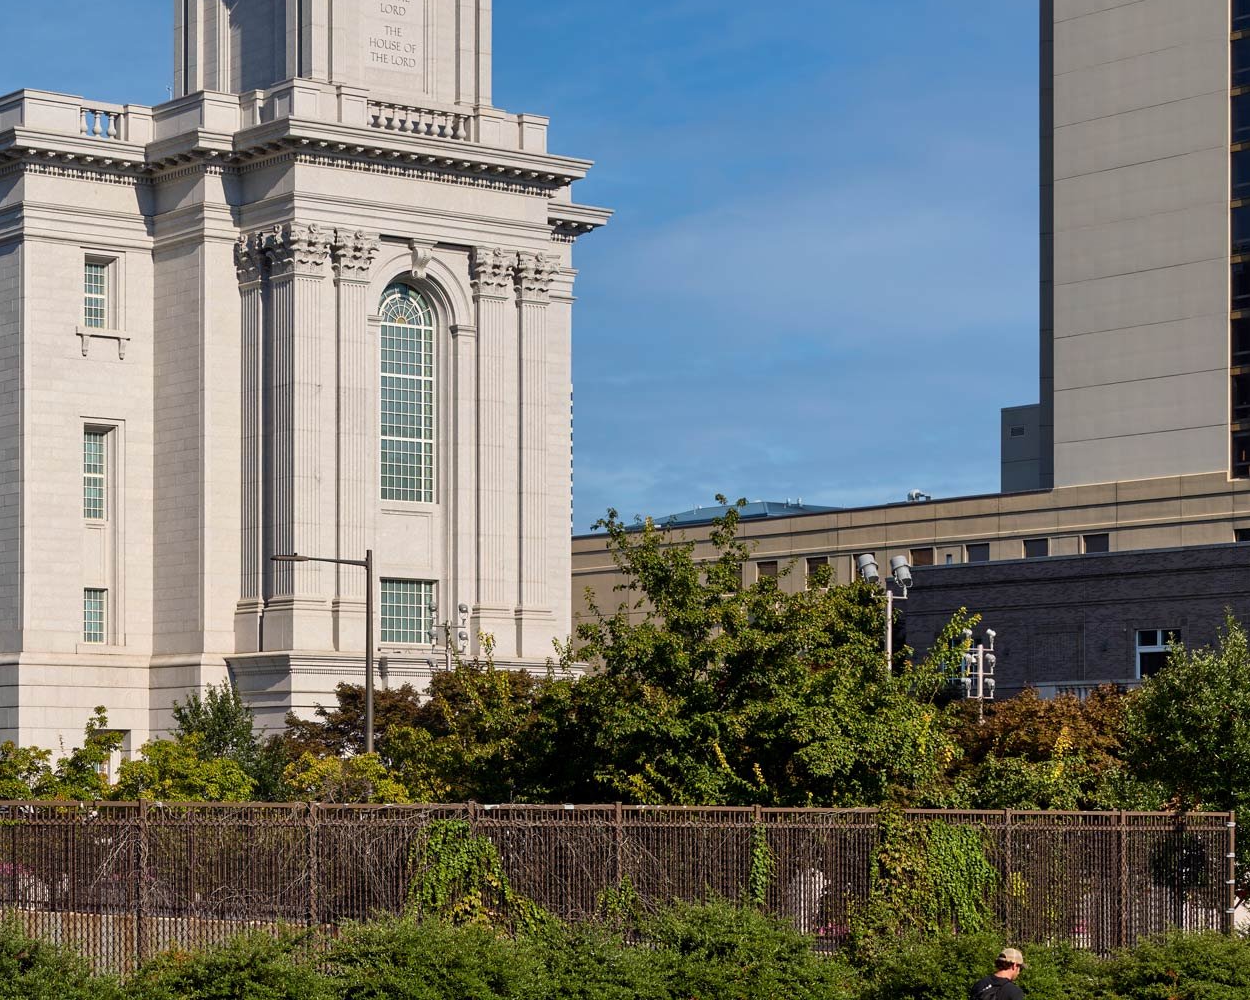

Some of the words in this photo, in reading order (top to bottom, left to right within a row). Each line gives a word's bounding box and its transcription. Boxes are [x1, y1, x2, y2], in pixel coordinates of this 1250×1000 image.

[380, 3, 406, 16] LORD
[384, 25, 402, 36] THE
[369, 37, 401, 51] HOUSE
[404, 43, 417, 54] OF
[370, 51, 389, 64] THE
[391, 55, 416, 68] LORD
